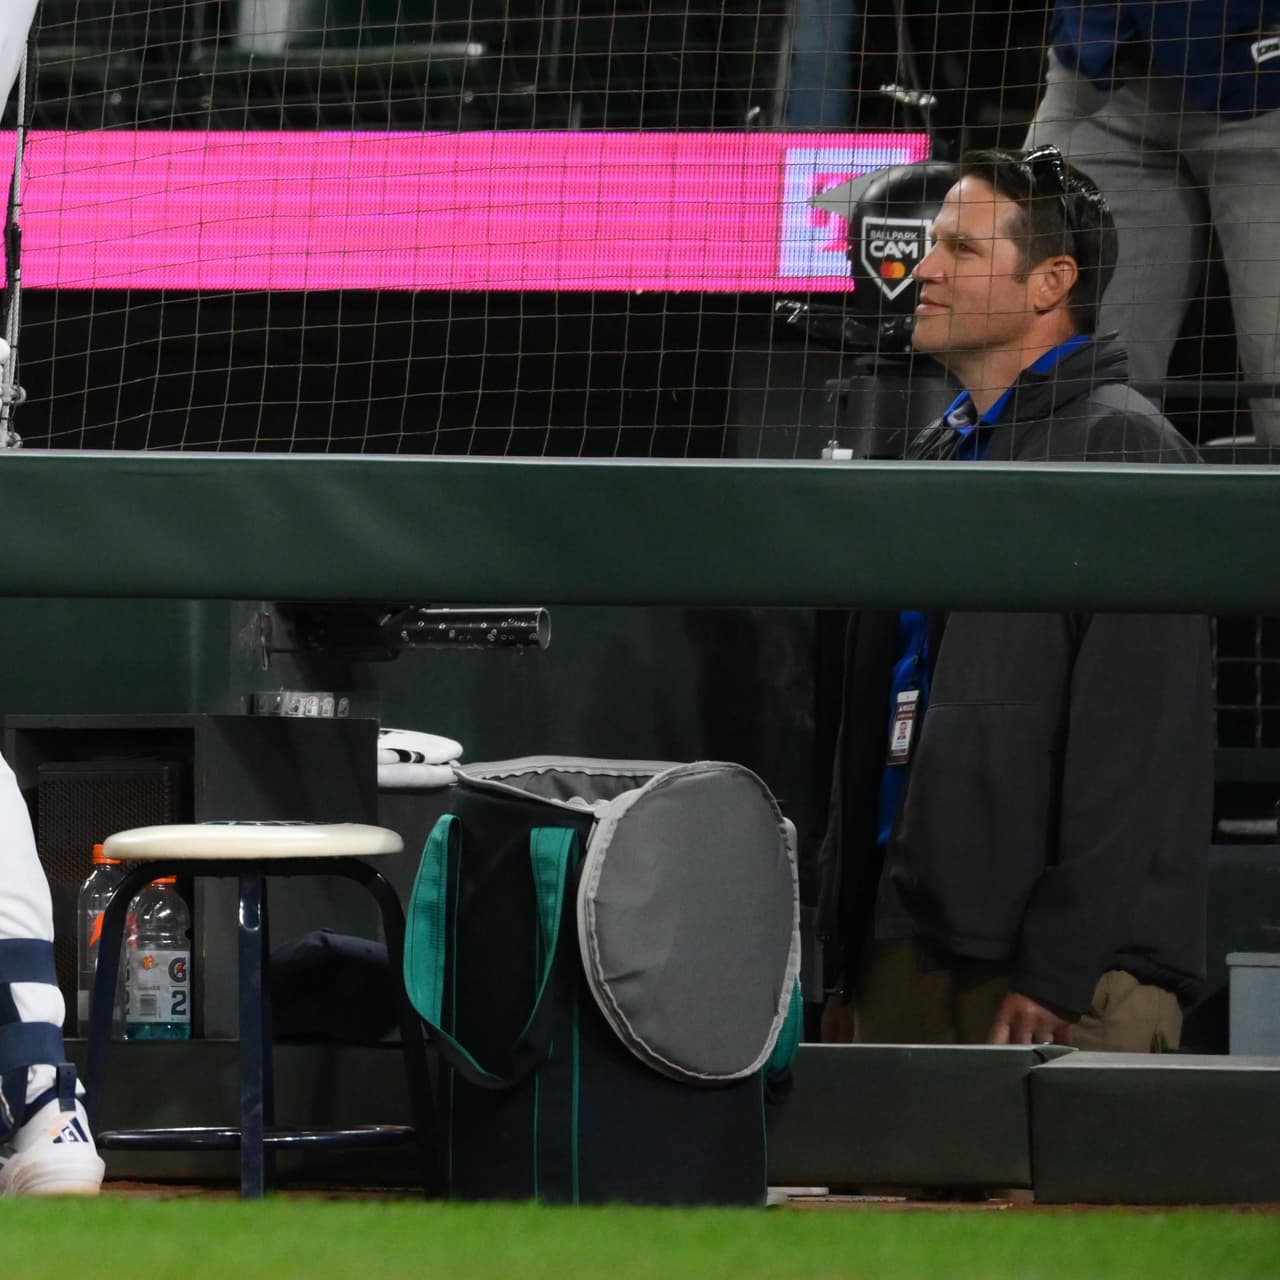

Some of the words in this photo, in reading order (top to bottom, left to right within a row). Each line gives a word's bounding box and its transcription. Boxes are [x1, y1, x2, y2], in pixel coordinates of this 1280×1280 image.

[869, 229, 919, 240] BALLPARK
[869, 240, 920, 259] CAM
[170, 989, 188, 1016] 2
